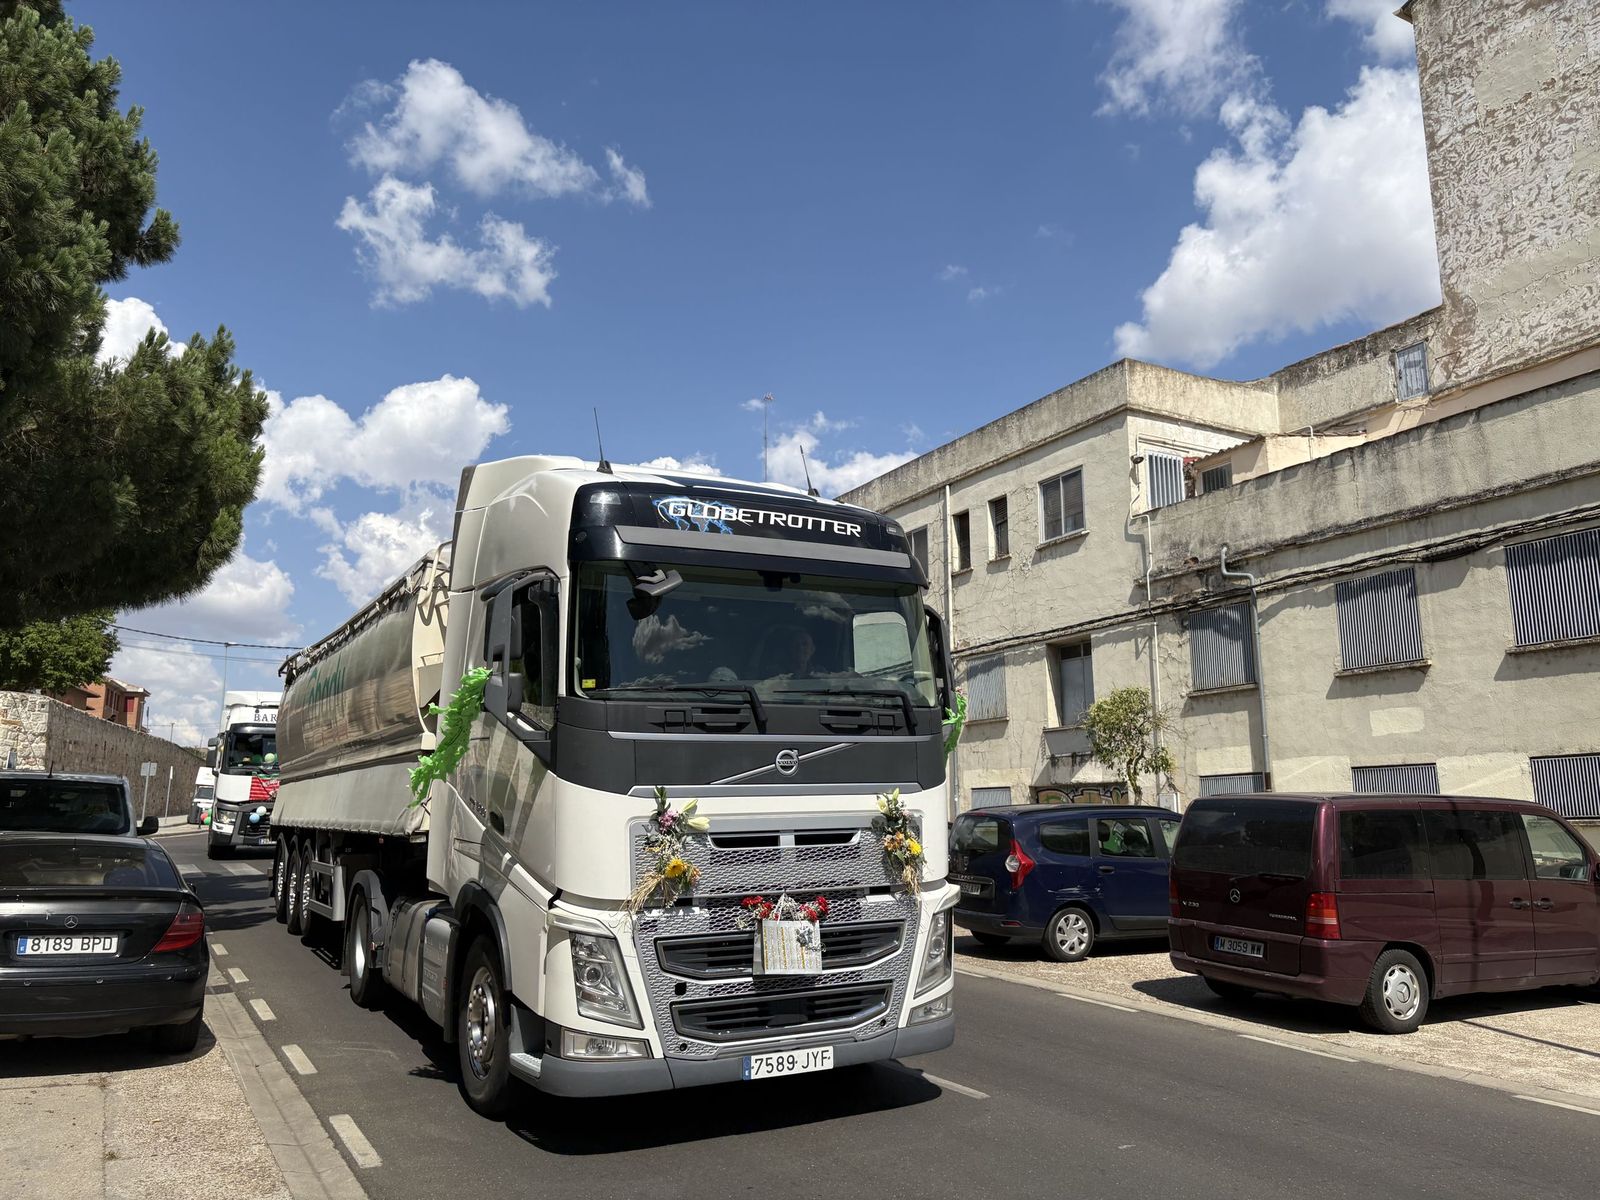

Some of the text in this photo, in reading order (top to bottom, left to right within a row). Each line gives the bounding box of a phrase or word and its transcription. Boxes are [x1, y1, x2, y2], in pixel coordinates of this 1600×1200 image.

[668, 502, 862, 538] GLOBETROTTER
[30, 936, 73, 952] 8189
[80, 936, 113, 952] BPD
[1227, 940, 1248, 952] 3059
[754, 1054, 796, 1076] 7589
[801, 1049, 830, 1069] JYF
